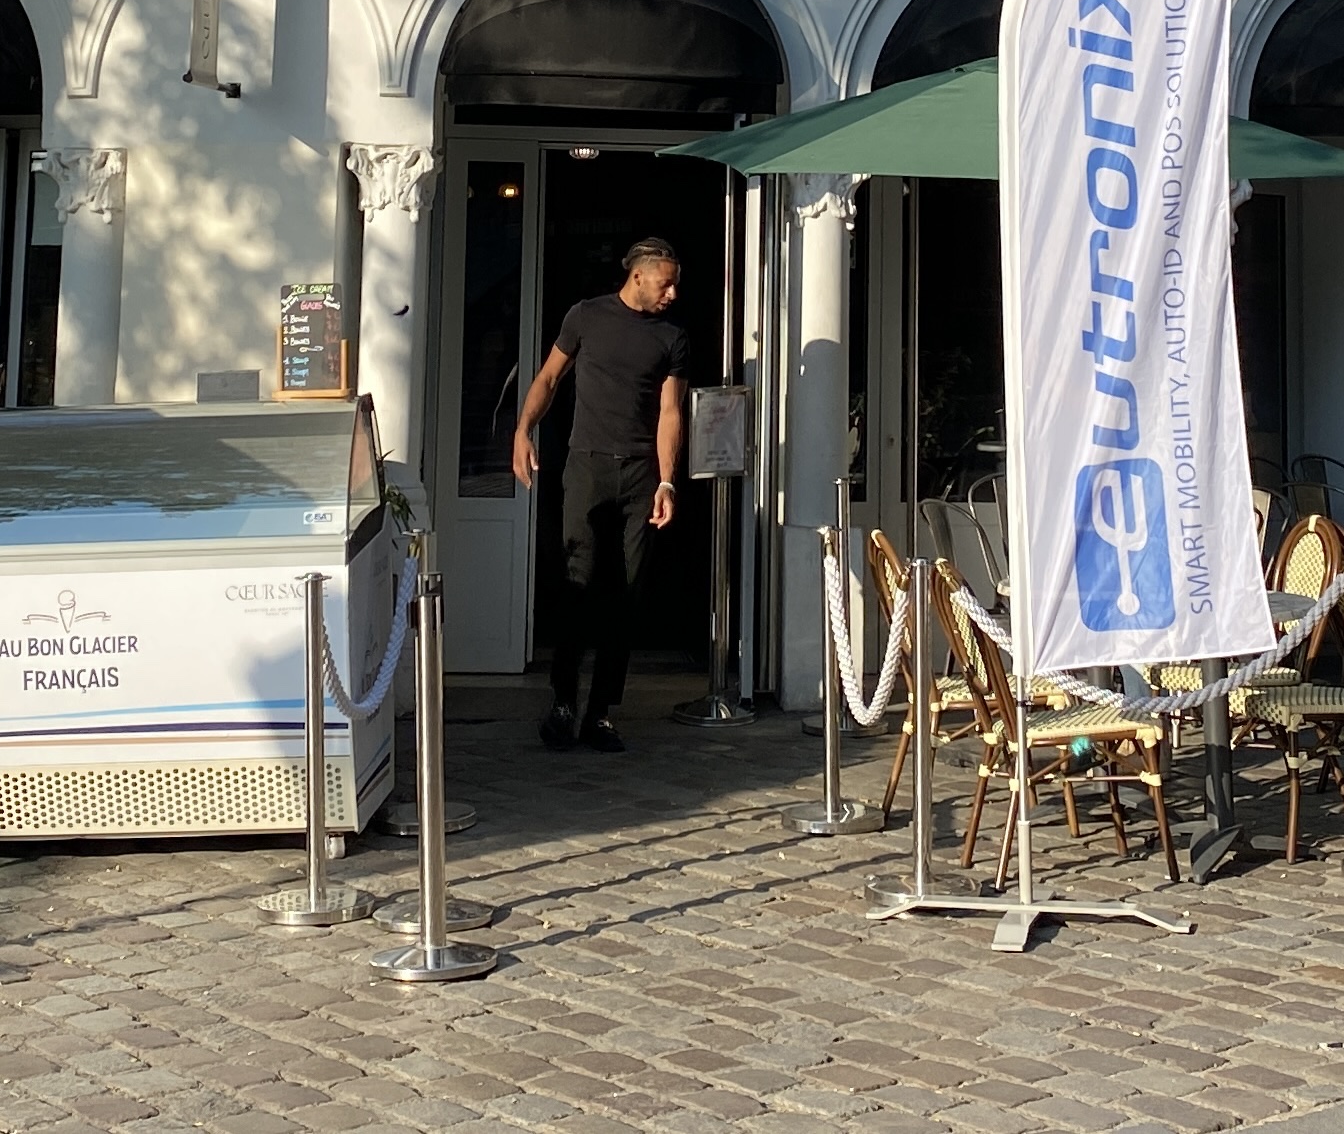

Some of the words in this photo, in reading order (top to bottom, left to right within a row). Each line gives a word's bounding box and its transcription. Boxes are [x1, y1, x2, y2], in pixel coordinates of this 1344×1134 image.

[1161, 116, 1183, 170] POS
[1163, 178, 1183, 239] AND
[1163, 248, 1186, 364] AUTO-ID
[1168, 372, 1201, 510] MOBILITY,
[1181, 518, 1213, 614] SMART
[27, 637, 64, 657] BON
[69, 635, 139, 655] GLACIER
[22, 666, 120, 694] FRANÇAIS
